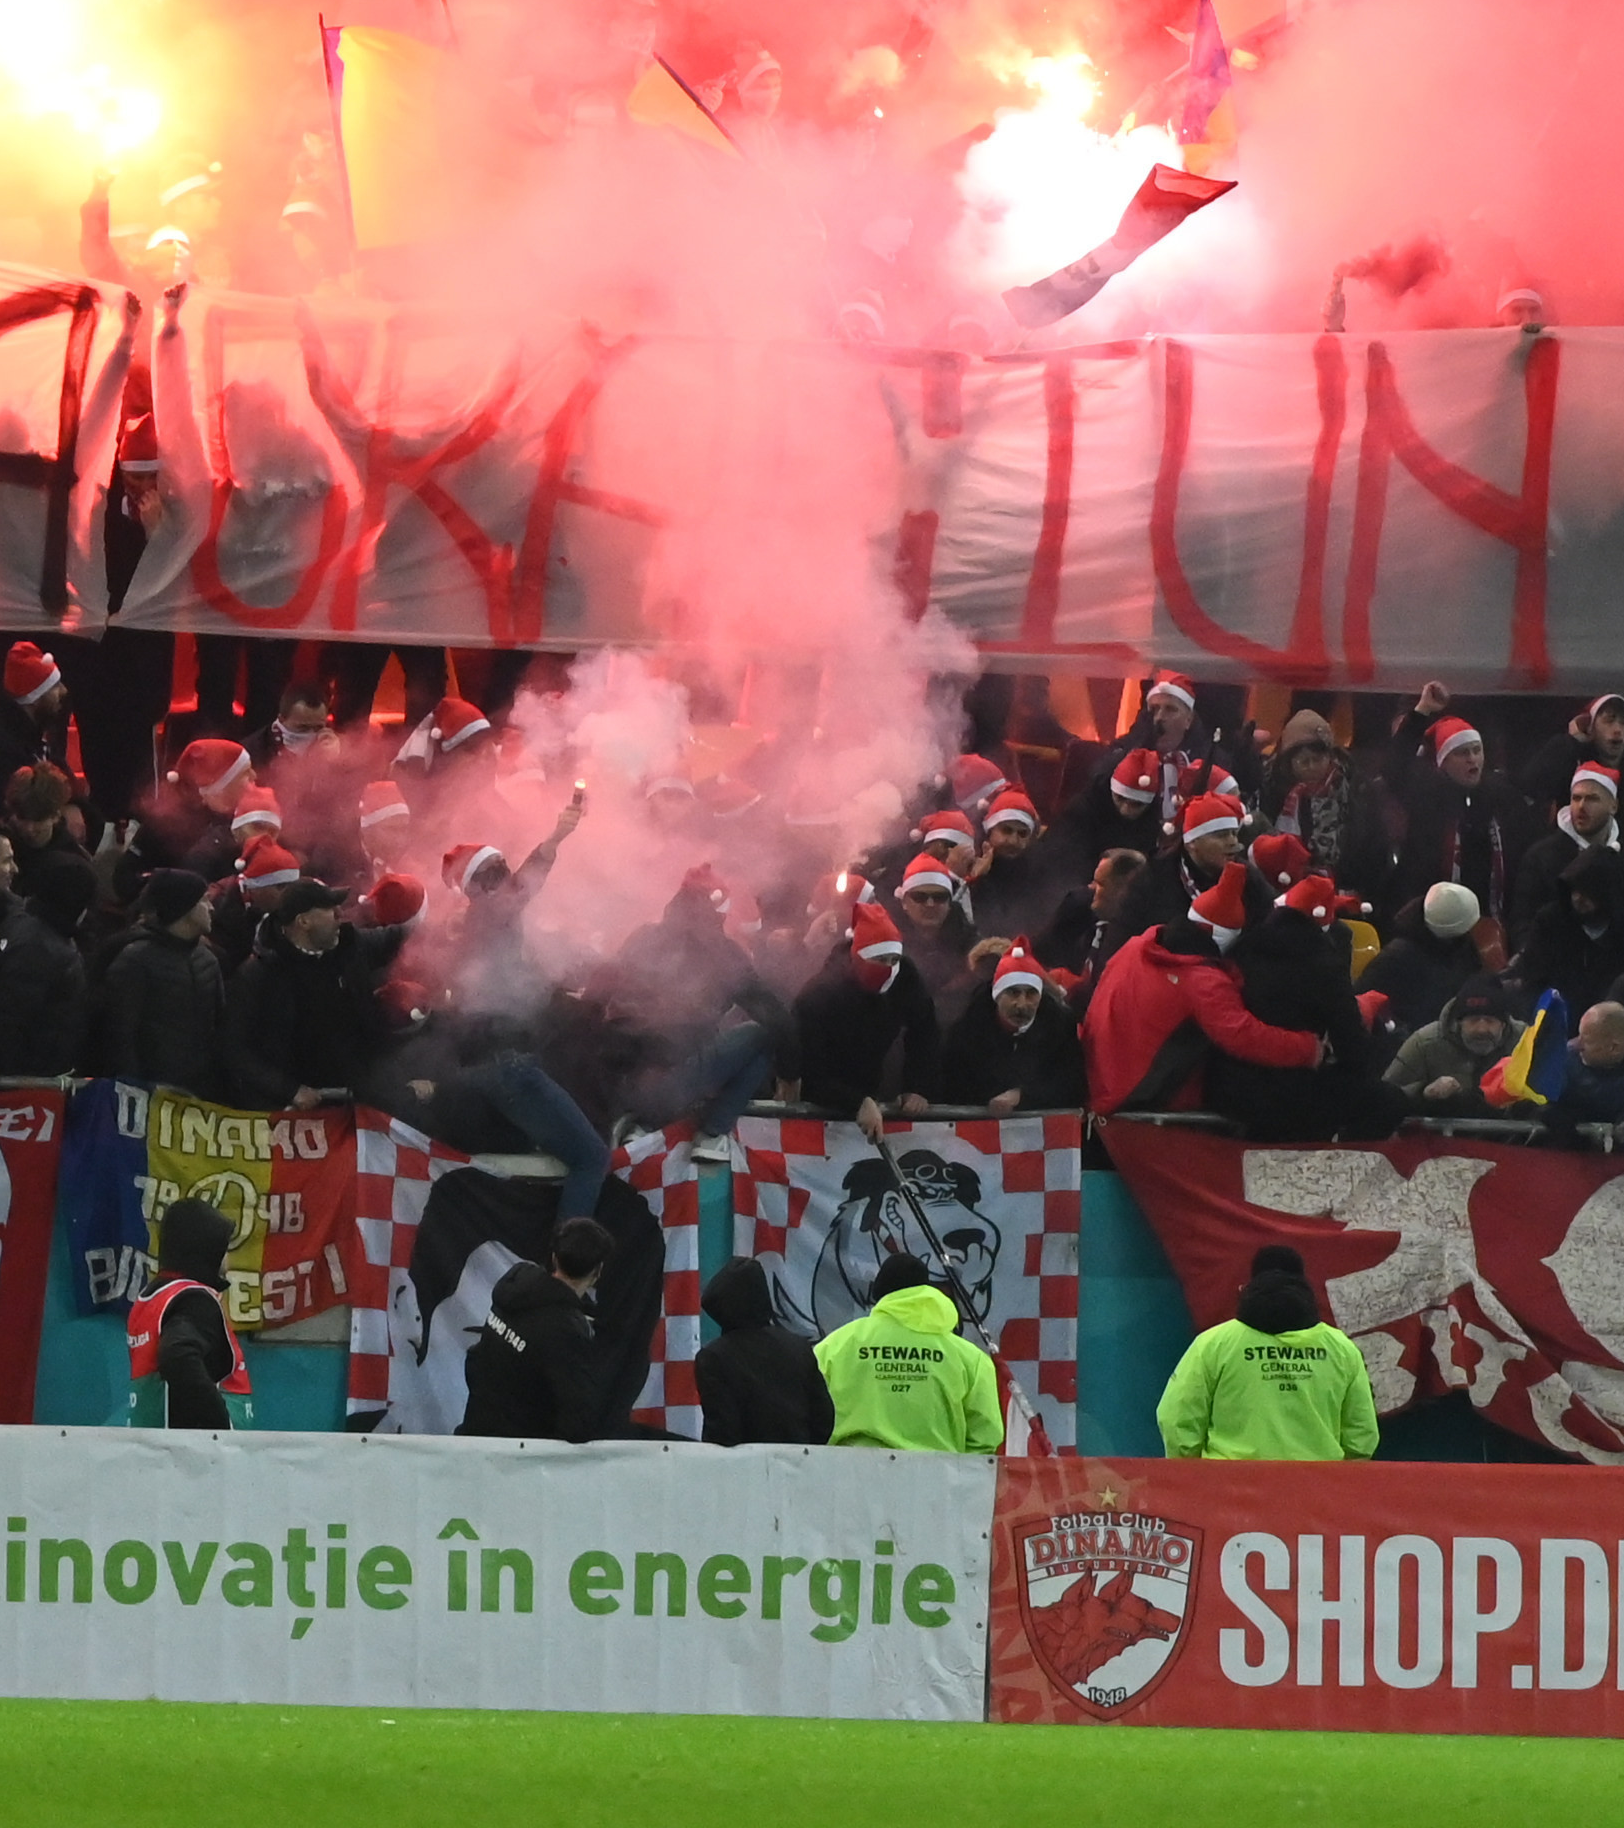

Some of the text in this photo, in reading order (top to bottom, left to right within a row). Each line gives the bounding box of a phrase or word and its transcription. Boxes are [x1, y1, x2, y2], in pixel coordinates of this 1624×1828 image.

[114, 1080, 329, 1161] DINAMO
[504, 1328, 526, 1352] 1948
[858, 1345, 944, 1364] STEWARD
[1243, 1345, 1328, 1362] STEWARD
[875, 1362, 929, 1373] GENERAL
[1260, 1362, 1313, 1373] GENERAL
[891, 1383, 911, 1393] 027
[1050, 1512, 1166, 1533] Fotbal Club
[1029, 1528, 1190, 1567] DINAMO
[5, 1516, 413, 1640] inovație
[437, 1517, 534, 1614] în
[568, 1540, 957, 1642] energie
[1088, 1687, 1127, 1707] 1948
